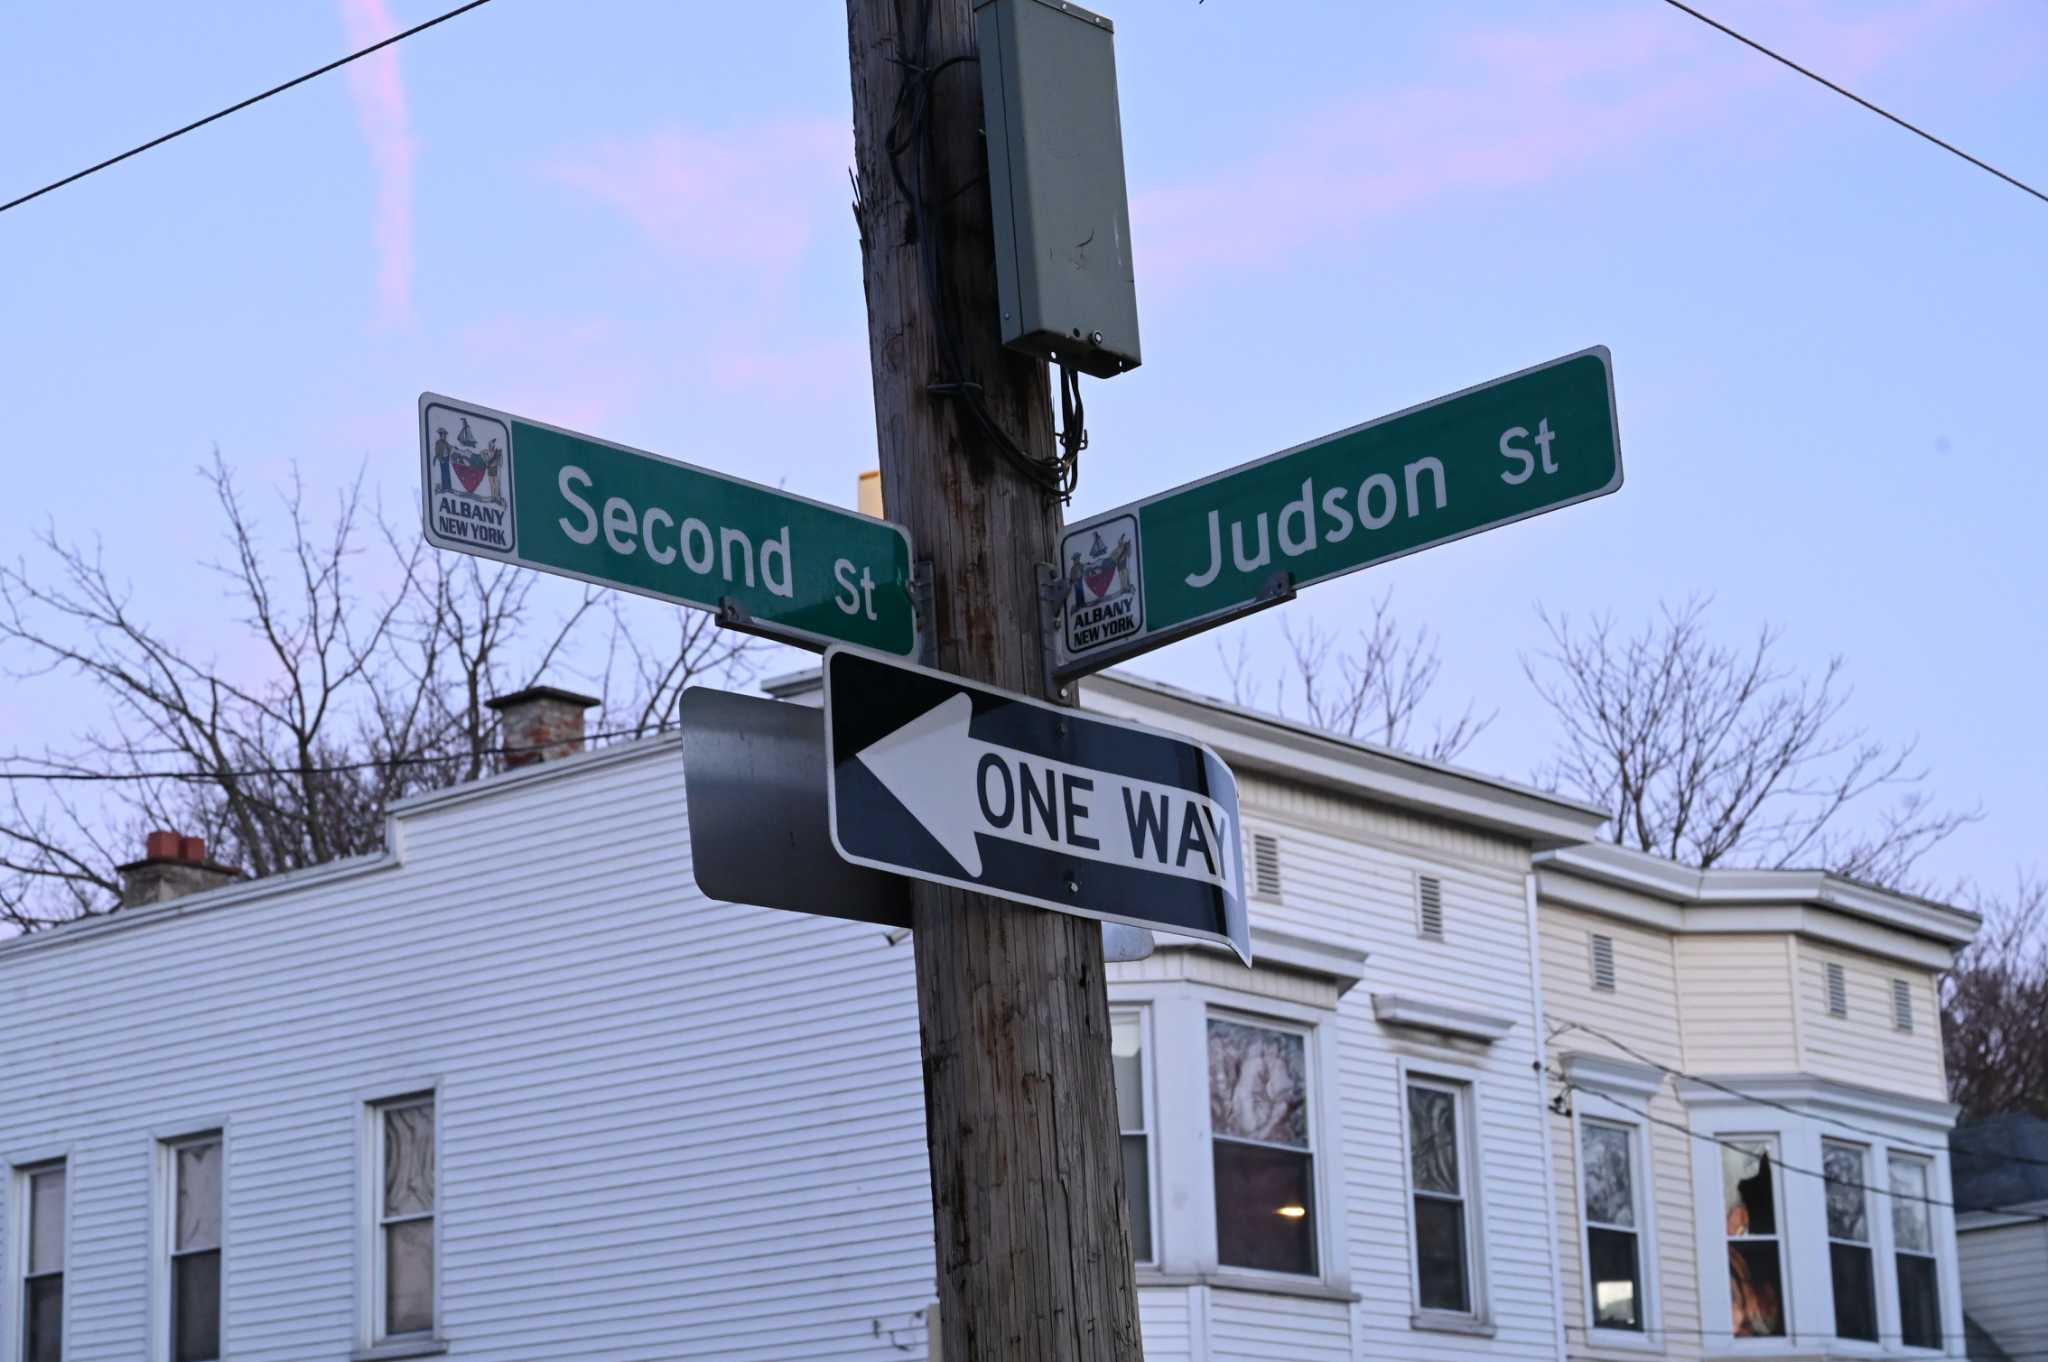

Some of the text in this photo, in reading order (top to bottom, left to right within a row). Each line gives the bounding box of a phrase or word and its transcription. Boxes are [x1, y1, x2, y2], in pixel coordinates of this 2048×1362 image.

[439, 497, 505, 526] ALBANY
[1184, 416, 1559, 588] Judson St
[439, 516, 506, 546] NEW YORK
[558, 465, 878, 621] Second St
[1074, 597, 1134, 630] ALBANY
[1074, 615, 1135, 648] NEW YORK
[976, 752, 1226, 880] ONE WAY
